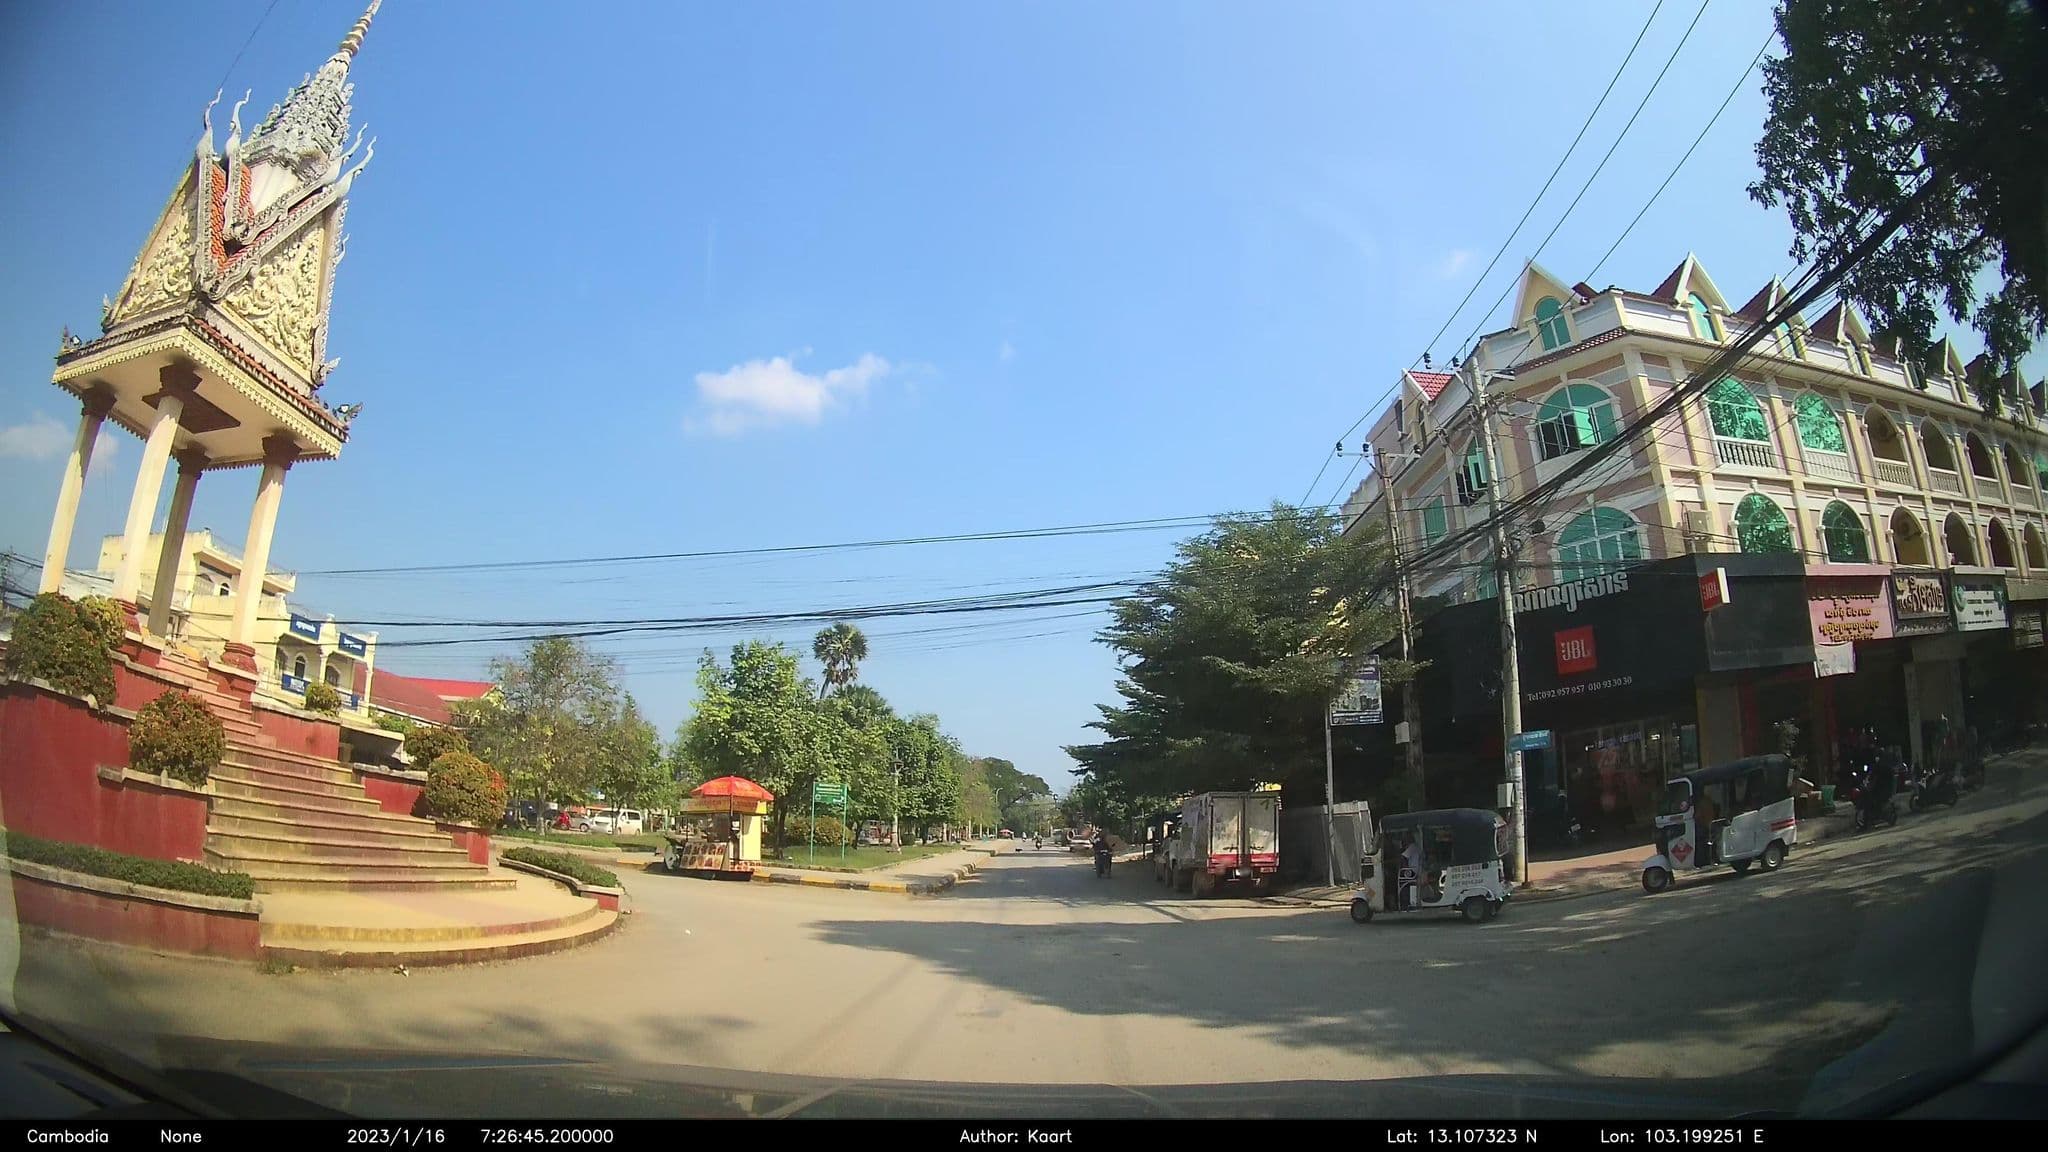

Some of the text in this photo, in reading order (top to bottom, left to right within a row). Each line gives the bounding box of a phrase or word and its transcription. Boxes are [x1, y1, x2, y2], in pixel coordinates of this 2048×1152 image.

[1702, 582, 1719, 600] JBL
[1561, 639, 1591, 661] JBL
[1557, 687, 1571, 697] 957
[1571, 685, 1585, 695] 957
[1588, 682, 1602, 692] 010
[1602, 680, 1612, 689] 93
[1612, 678, 1622, 687] 30
[1622, 675, 1632, 685] 30
